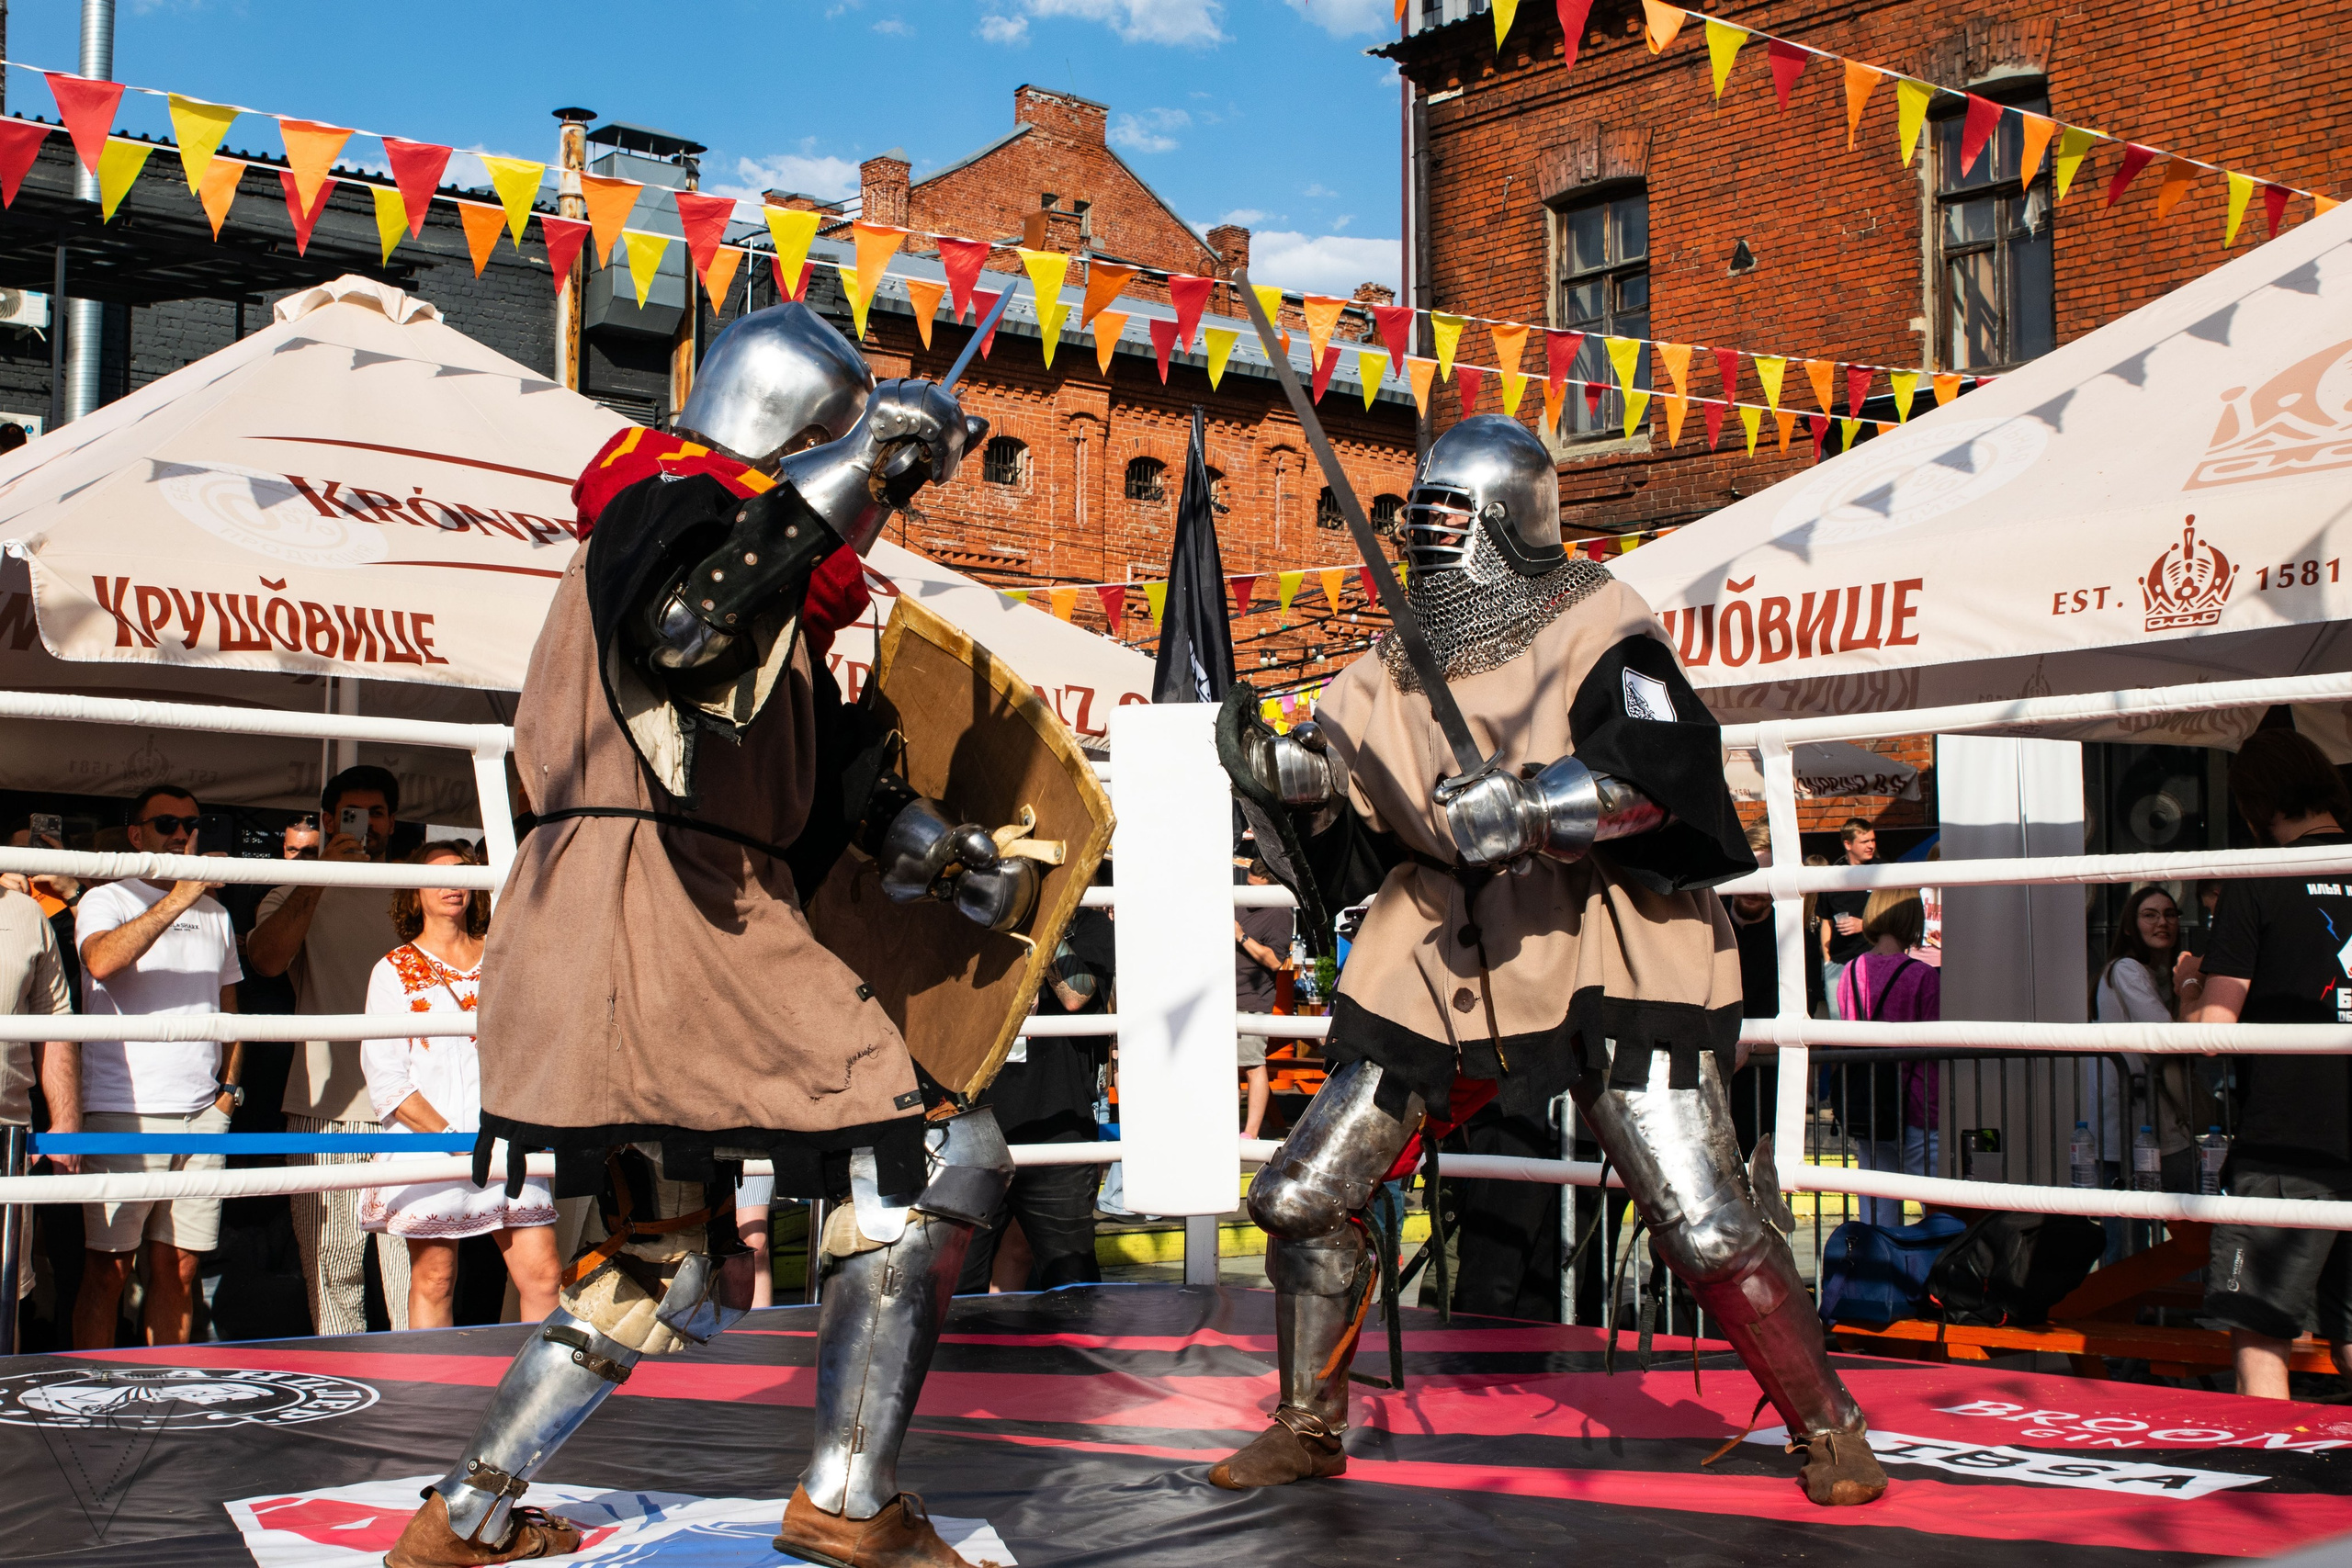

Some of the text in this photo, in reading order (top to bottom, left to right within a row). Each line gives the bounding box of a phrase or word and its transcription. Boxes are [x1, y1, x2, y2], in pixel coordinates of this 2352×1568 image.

[277, 468, 581, 546] KRÓNP
[2052, 557, 2340, 615] EST. 1581
[2306, 883, 2343, 896] ИЛЬЯ
[1930, 1399, 2352, 1453] BROOM
[2020, 1428, 2145, 1449] GIN
